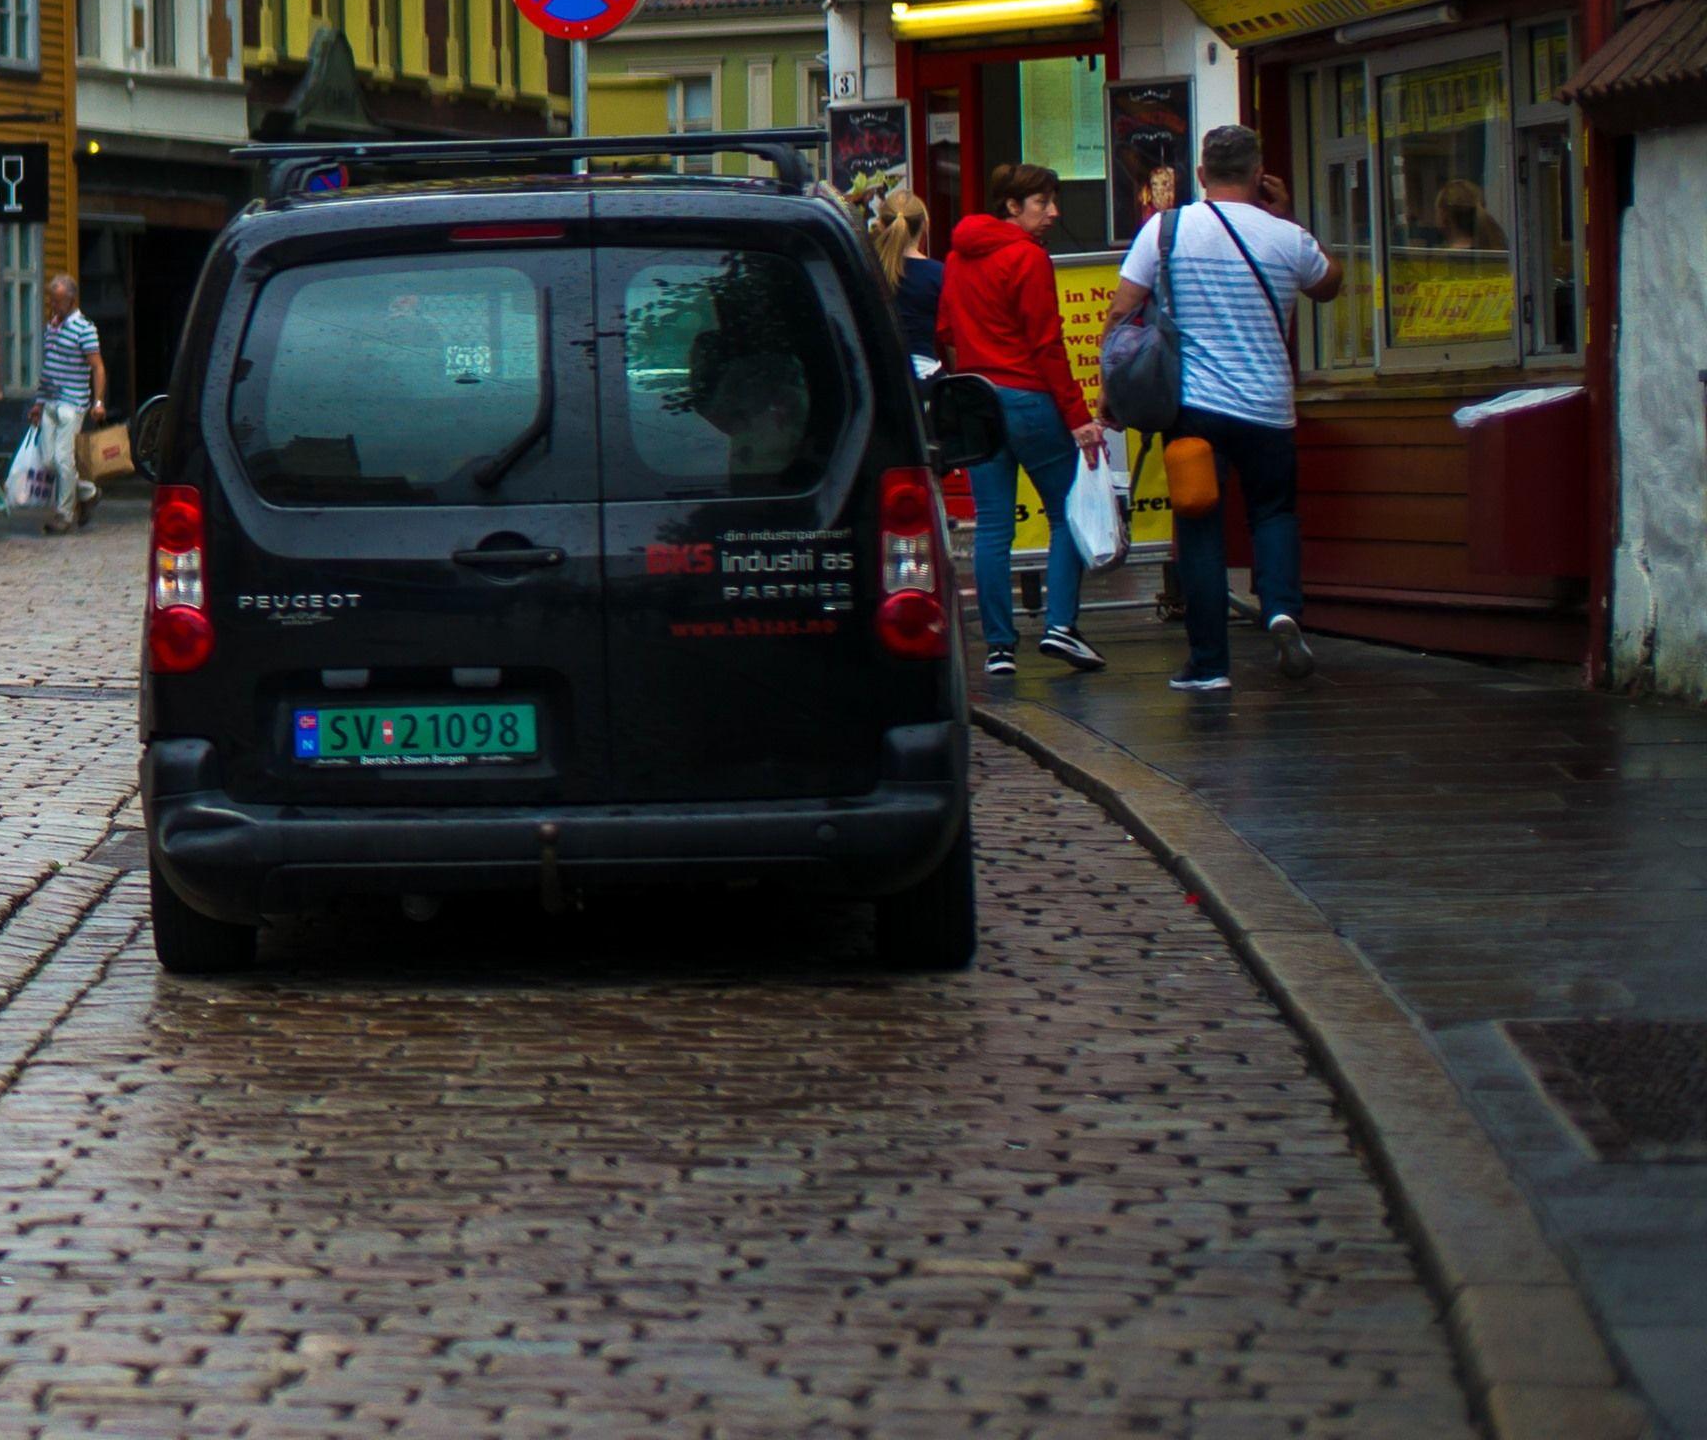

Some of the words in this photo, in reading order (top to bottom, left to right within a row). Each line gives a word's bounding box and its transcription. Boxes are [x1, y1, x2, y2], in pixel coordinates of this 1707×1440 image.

[840, 75, 850, 95] 3
[1065, 290, 1085, 304] in
[1090, 287, 1116, 302] No
[1071, 312, 1092, 324] as
[1077, 353, 1100, 367] ha
[821, 552, 855, 572] as
[722, 582, 853, 601] PARTNER
[237, 593, 363, 609] PEUGEOT
[329, 713, 377, 751] SV
[399, 711, 521, 750] 21098
